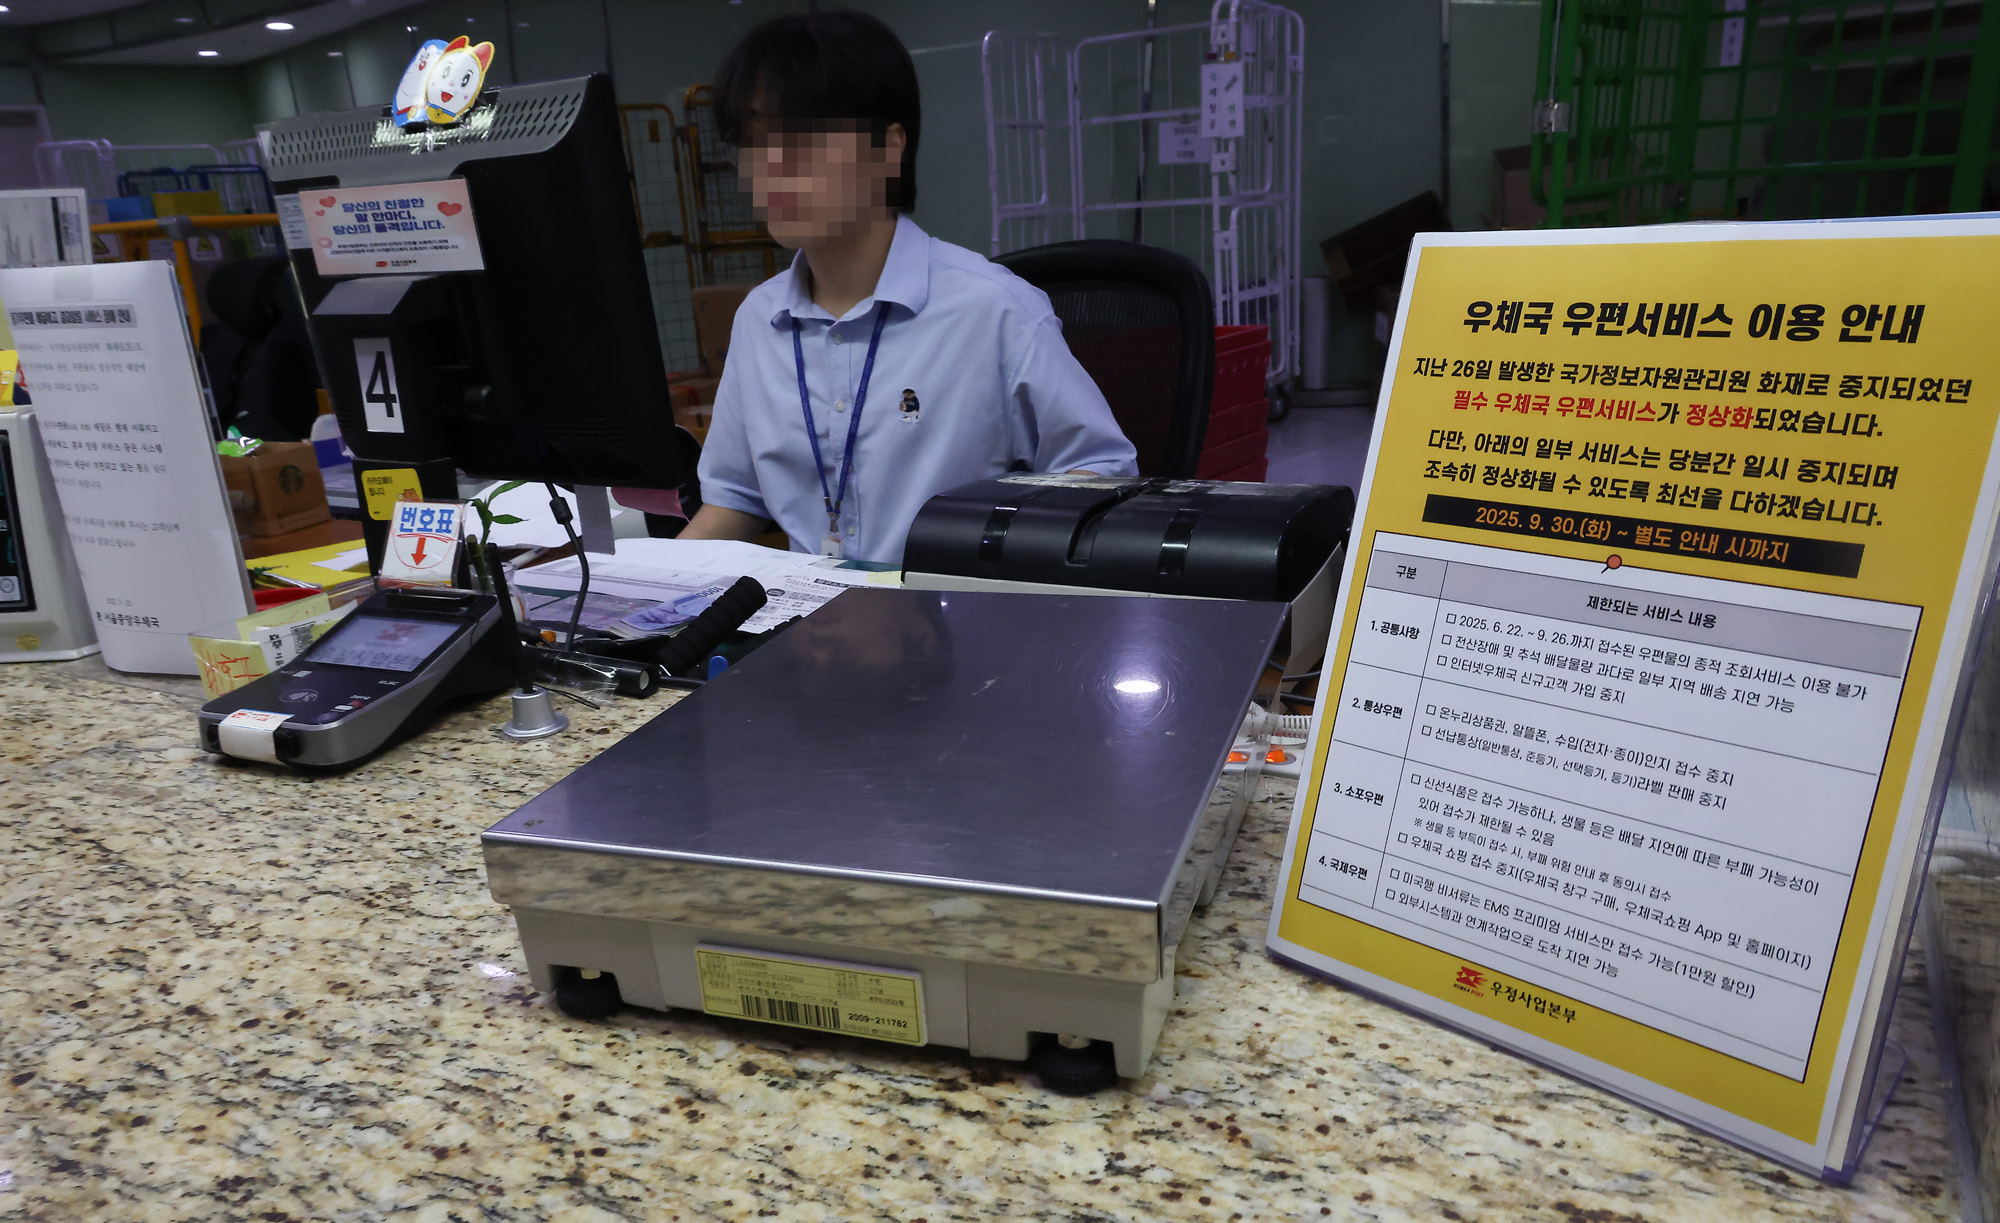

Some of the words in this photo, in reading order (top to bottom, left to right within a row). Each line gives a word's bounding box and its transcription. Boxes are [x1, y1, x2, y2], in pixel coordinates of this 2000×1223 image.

[332, 223, 371, 235] 당신의
[375, 219, 446, 232] 품격입니다.
[341, 200, 381, 213] 당신의
[384, 198, 425, 210] 친절한
[1463, 300, 1554, 335] 우체국
[1562, 302, 1734, 339] 우편서비스
[1748, 303, 1826, 342] 이용
[1838, 304, 1926, 344] 안내
[366, 351, 397, 417] 4
[1413, 357, 1448, 378] 지난
[1451, 359, 1493, 380] 26일
[1498, 360, 1555, 383] 발생한
[1560, 363, 1751, 393] 국가정보자원관리원
[1756, 370, 1831, 396] 화재로
[1838, 374, 1973, 404] 중지되었던
[1453, 390, 1489, 411] 필수
[1494, 392, 1551, 416] 우체국
[1555, 396, 1680, 424] 우편서비스가
[1686, 403, 1883, 438] 정상화되었습니다.
[1428, 429, 1467, 453] 다만,
[1474, 433, 1529, 457] 아래의
[1535, 438, 1574, 461] 일부
[1577, 441, 1661, 469] 서비스는
[1668, 448, 1737, 476] 당분간
[1742, 454, 1790, 481] 일시
[1797, 459, 1899, 490] 중지되며
[1423, 460, 1477, 484] 조속히
[1482, 465, 1557, 493] 정상화될
[1562, 474, 1582, 495] 수
[1587, 476, 1651, 503] 있도록
[1655, 482, 1723, 511] 최선을
[1729, 490, 1882, 527] 다하겠습니다.
[399, 507, 454, 533] 번호표
[1475, 507, 1522, 528] 2025.
[1634, 525, 1673, 547] 별도
[1679, 530, 1720, 554] 안내
[1724, 536, 1790, 563] 시까지
[1396, 565, 1417, 580] 구분
[1380, 621, 1420, 640] 공통사항
[1586, 595, 1639, 617] 제한되는
[1642, 604, 1684, 623] 서비스
[1688, 611, 1717, 629] 내용
[1450, 656, 1518, 682] 인터넷우체국
[1520, 671, 1568, 693] 신규고객
[1571, 681, 1597, 698] 가입
[1600, 687, 1625, 704] 중지
[1455, 635, 1500, 656] 전산장애
[1502, 644, 1515, 659] 및
[1517, 647, 1541, 664] 추석
[1544, 653, 1594, 674] 배달물량
[1596, 662, 1635, 682] 과다로
[1638, 670, 1665, 687] 일부
[1668, 676, 1696, 694] 지역
[1699, 682, 1727, 700] 배송
[1731, 688, 1761, 707] 지연
[1765, 695, 1795, 713] 가능
[1459, 615, 1489, 631] 2025.
[1506, 623, 1523, 637] 22.
[1551, 631, 1595, 651] 26.까지
[1598, 639, 1635, 659] 접수된
[1638, 647, 1691, 669] 우편물의
[1694, 657, 1722, 674] 종적
[1724, 662, 1796, 688] 조회서비스
[1801, 676, 1832, 694] 이용
[1836, 682, 1867, 701] 불가
[1363, 699, 1403, 720] 통상우편
[1439, 707, 1508, 735] 온누리상품권,
[1675, 760, 1701, 779] 접수
[1706, 768, 1734, 787] 중지
[1344, 785, 1384, 807] 소포우편
[1526, 750, 1559, 769] 준등기,
[1562, 760, 1607, 781] 선택등기,
[1667, 783, 1695, 803] 판매
[1699, 791, 1727, 810] 중지
[1418, 797, 1440, 814] 있어
[1443, 803, 1476, 824] 접수가
[1478, 813, 1513, 835] 제한될
[1515, 825, 1527, 838] 수
[1530, 829, 1555, 847] 있음
[1424, 777, 1478, 802] 신선식품은
[1481, 791, 1503, 808] 접수
[1506, 798, 1556, 825] 가능하나,
[1561, 814, 1586, 832] 생물
[1589, 821, 1615, 840] 등은
[1618, 829, 1645, 848] 배달
[1648, 837, 1689, 860] 지연에
[1692, 849, 1721, 869] 따른
[1725, 858, 1755, 878] 부패
[1758, 867, 1819, 896] 가능성이
[1330, 858, 1368, 881] 국제우편
[1411, 836, 1443, 856] 우체국
[1445, 846, 1468, 863] 쇼핑
[1470, 853, 1492, 870] 접수
[1562, 882, 1587, 900] 창구
[1591, 890, 1619, 912] 구매,
[1624, 901, 1691, 933] 우체국쇼핑
[1694, 924, 1722, 944] App
[1727, 932, 1741, 949] 및
[1398, 892, 1463, 924] 외부시스템과
[1465, 915, 1534, 949] 연계작업으로
[1537, 939, 1562, 958] 도착
[1564, 948, 1590, 968] 지연
[1593, 958, 1618, 978] 가능
[1402, 871, 1435, 892] 미국행
[1437, 883, 1481, 908] 비서류는
[1483, 899, 1510, 917] EMS
[1512, 908, 1561, 935] 프리미엄
[1563, 925, 1615, 952] 서비스만
[1618, 942, 1643, 961] 접수
[1453, 983, 1471, 993] KOREA
[1490, 981, 1576, 1024] 우정사업본부
[848, 1012, 908, 1029] 2009-211782
